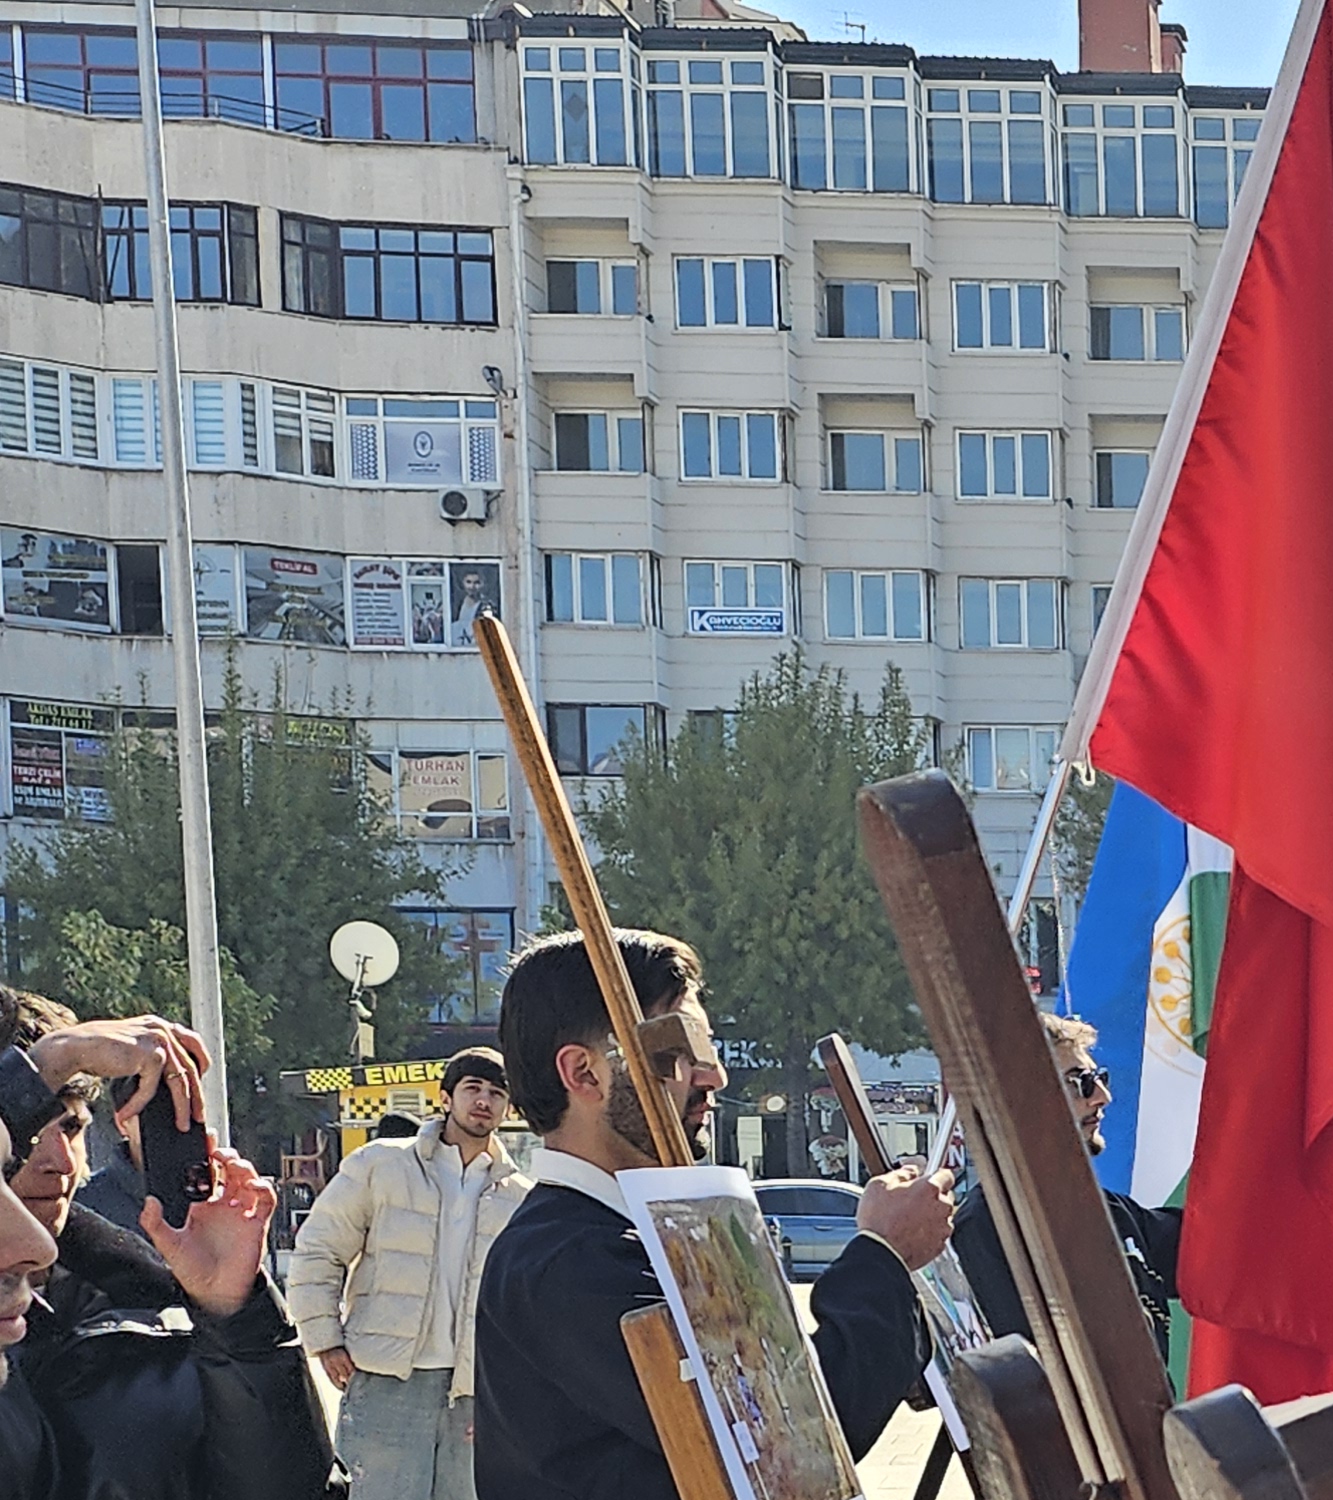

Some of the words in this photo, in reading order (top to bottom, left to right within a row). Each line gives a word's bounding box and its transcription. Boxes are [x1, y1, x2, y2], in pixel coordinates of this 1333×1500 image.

[407, 759, 465, 771] TURHAN
[412, 776, 460, 785] EMLAK
[364, 1061, 446, 1085] EMEK
